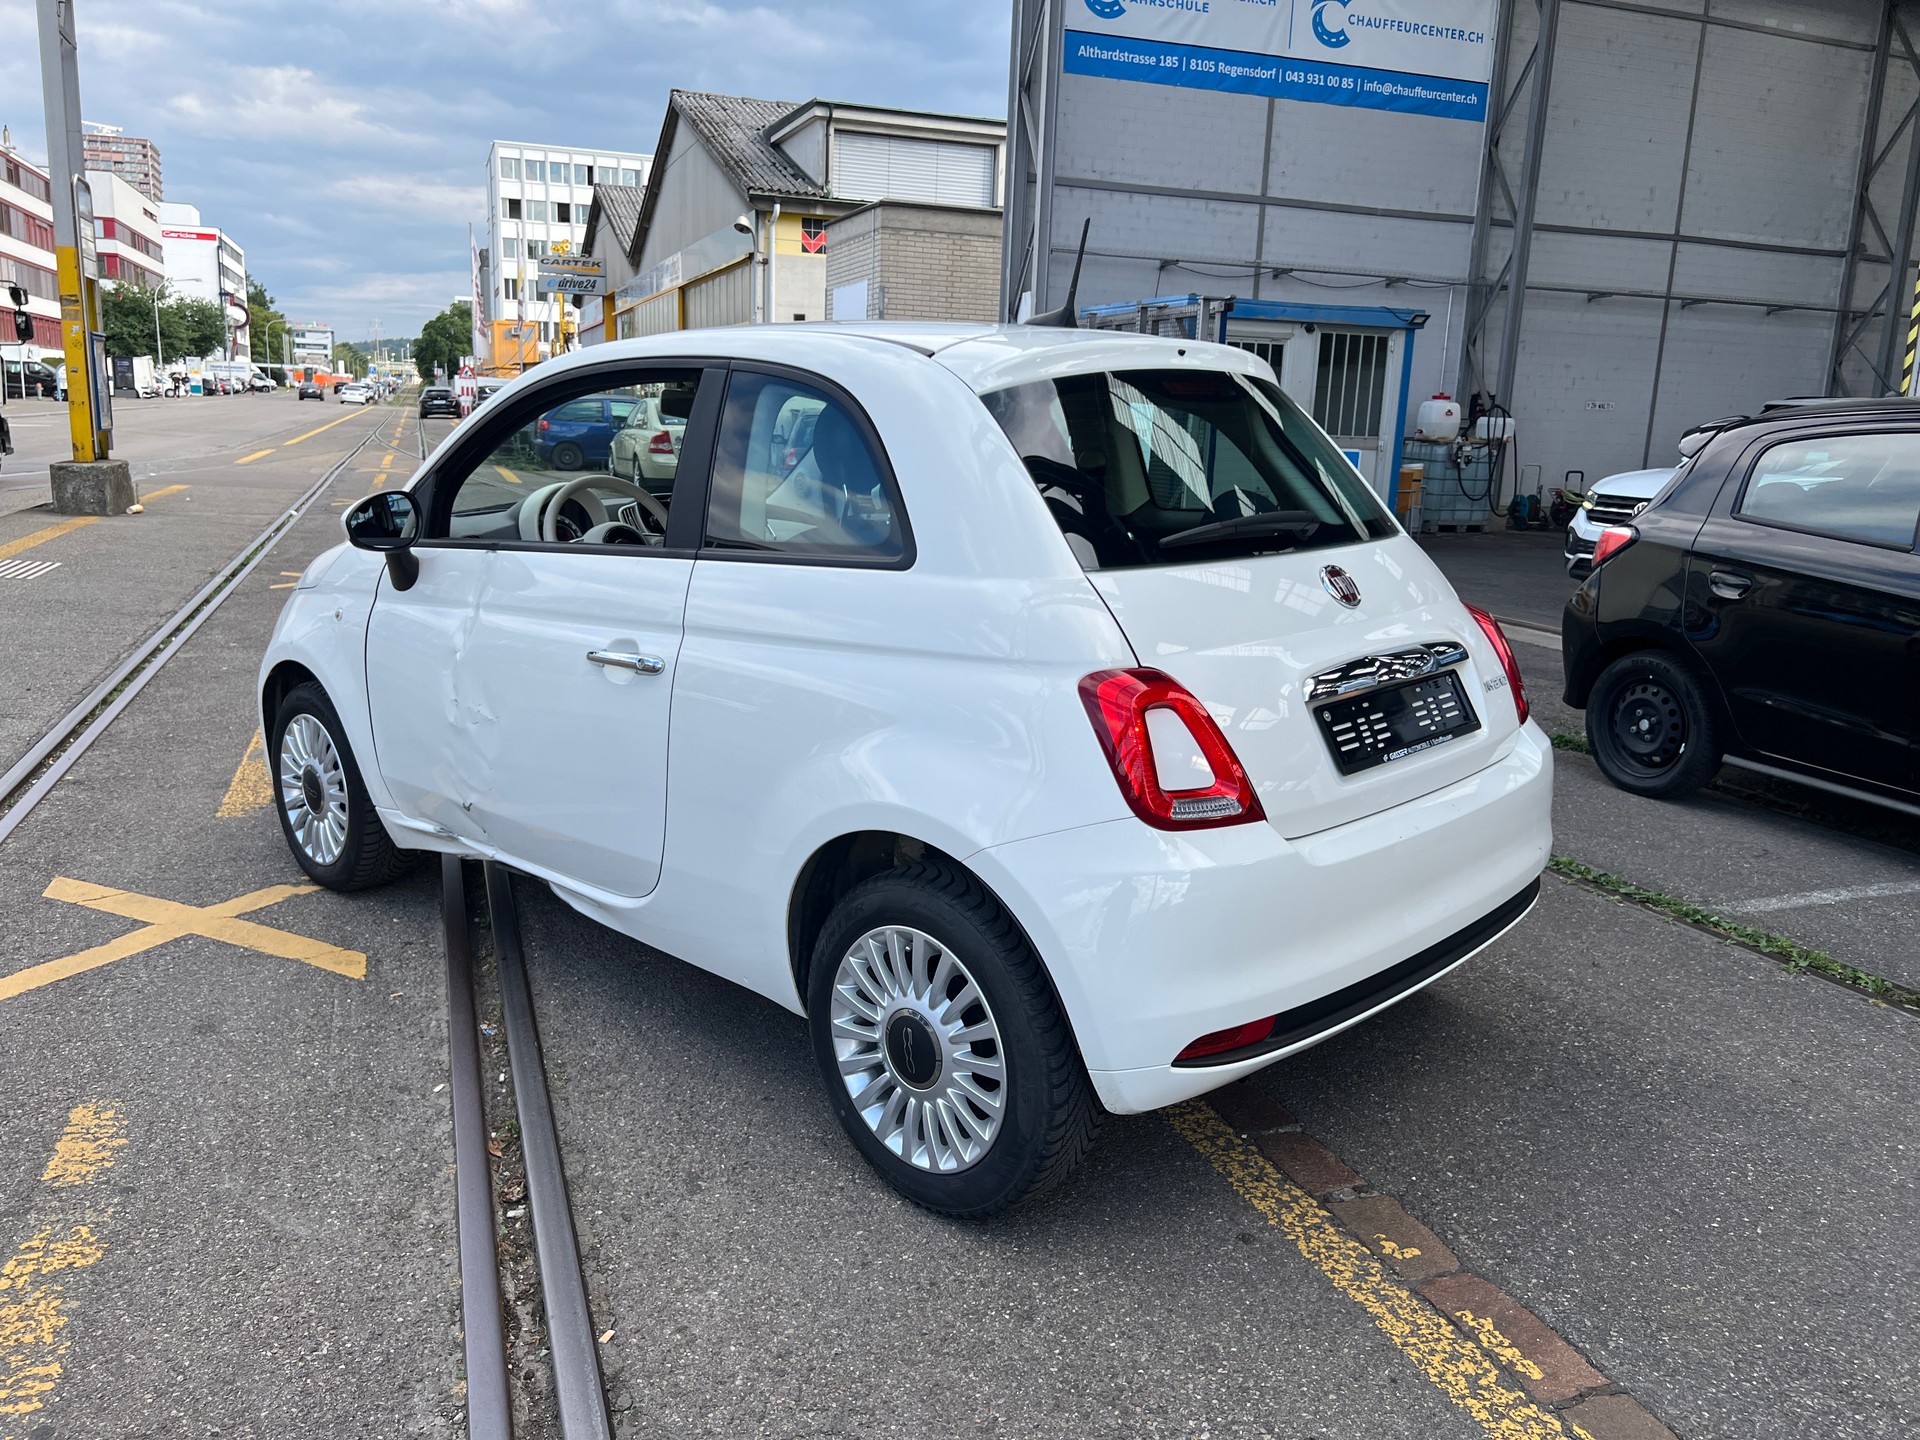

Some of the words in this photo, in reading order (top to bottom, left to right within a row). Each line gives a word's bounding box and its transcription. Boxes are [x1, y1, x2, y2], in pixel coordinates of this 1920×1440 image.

[1122, 0, 1210, 13] HRSCHULE
[1348, 14, 1484, 44] CHAUFFEURCENTER.CH
[1078, 45, 1156, 65] Althardstrasse
[1159, 55, 1179, 68] 185
[1190, 59, 1215, 73] 8105
[1218, 62, 1276, 79] Regensdorf
[1285, 70, 1303, 83] 043
[1307, 73, 1325, 86] 931
[1327, 75, 1340, 88] 00
[1341, 77, 1354, 89] 85
[1363, 80, 1478, 105] info@chauffeurcenter.ch
[541, 258, 602, 268] CARTEK
[558, 278, 597, 290] drive24
